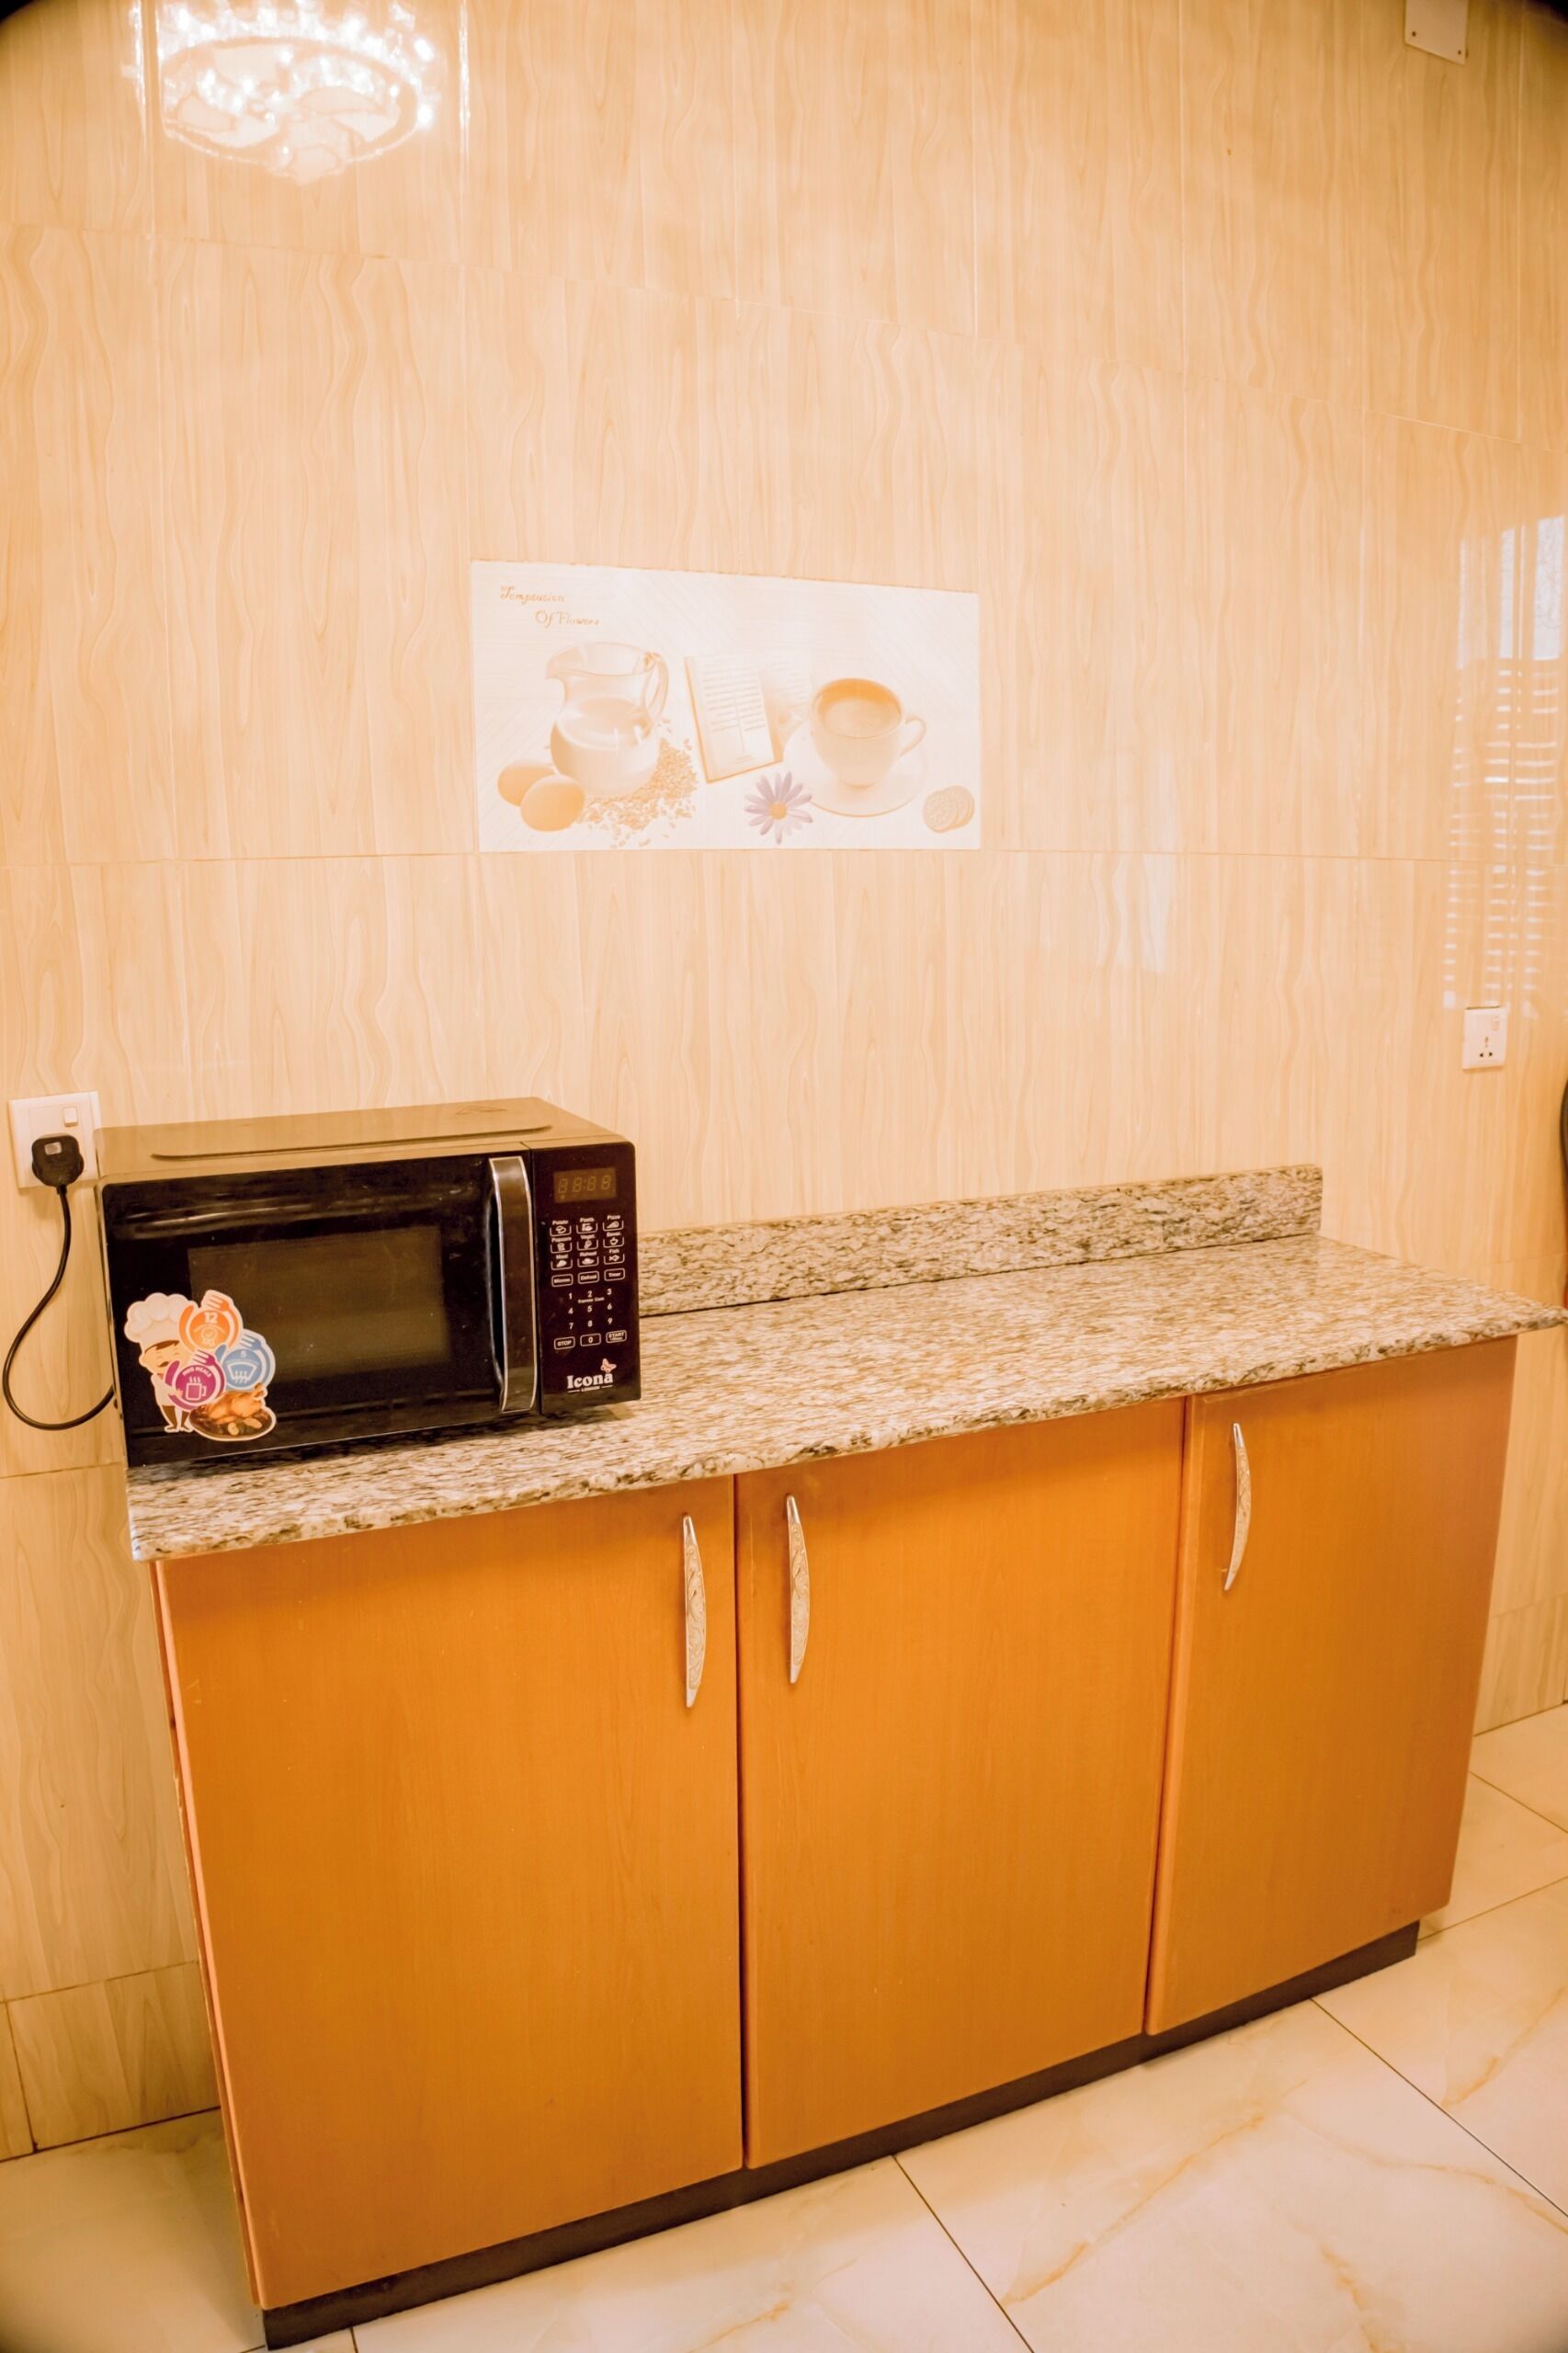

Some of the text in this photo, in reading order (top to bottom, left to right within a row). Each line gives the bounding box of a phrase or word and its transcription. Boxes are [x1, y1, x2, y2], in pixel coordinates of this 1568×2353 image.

[535, 609, 557, 629] Of
[587, 1290, 593, 1298] 2
[204, 1312, 218, 1324] 12
[569, 1322, 574, 1330] 7
[566, 1373, 613, 1389] Icona
